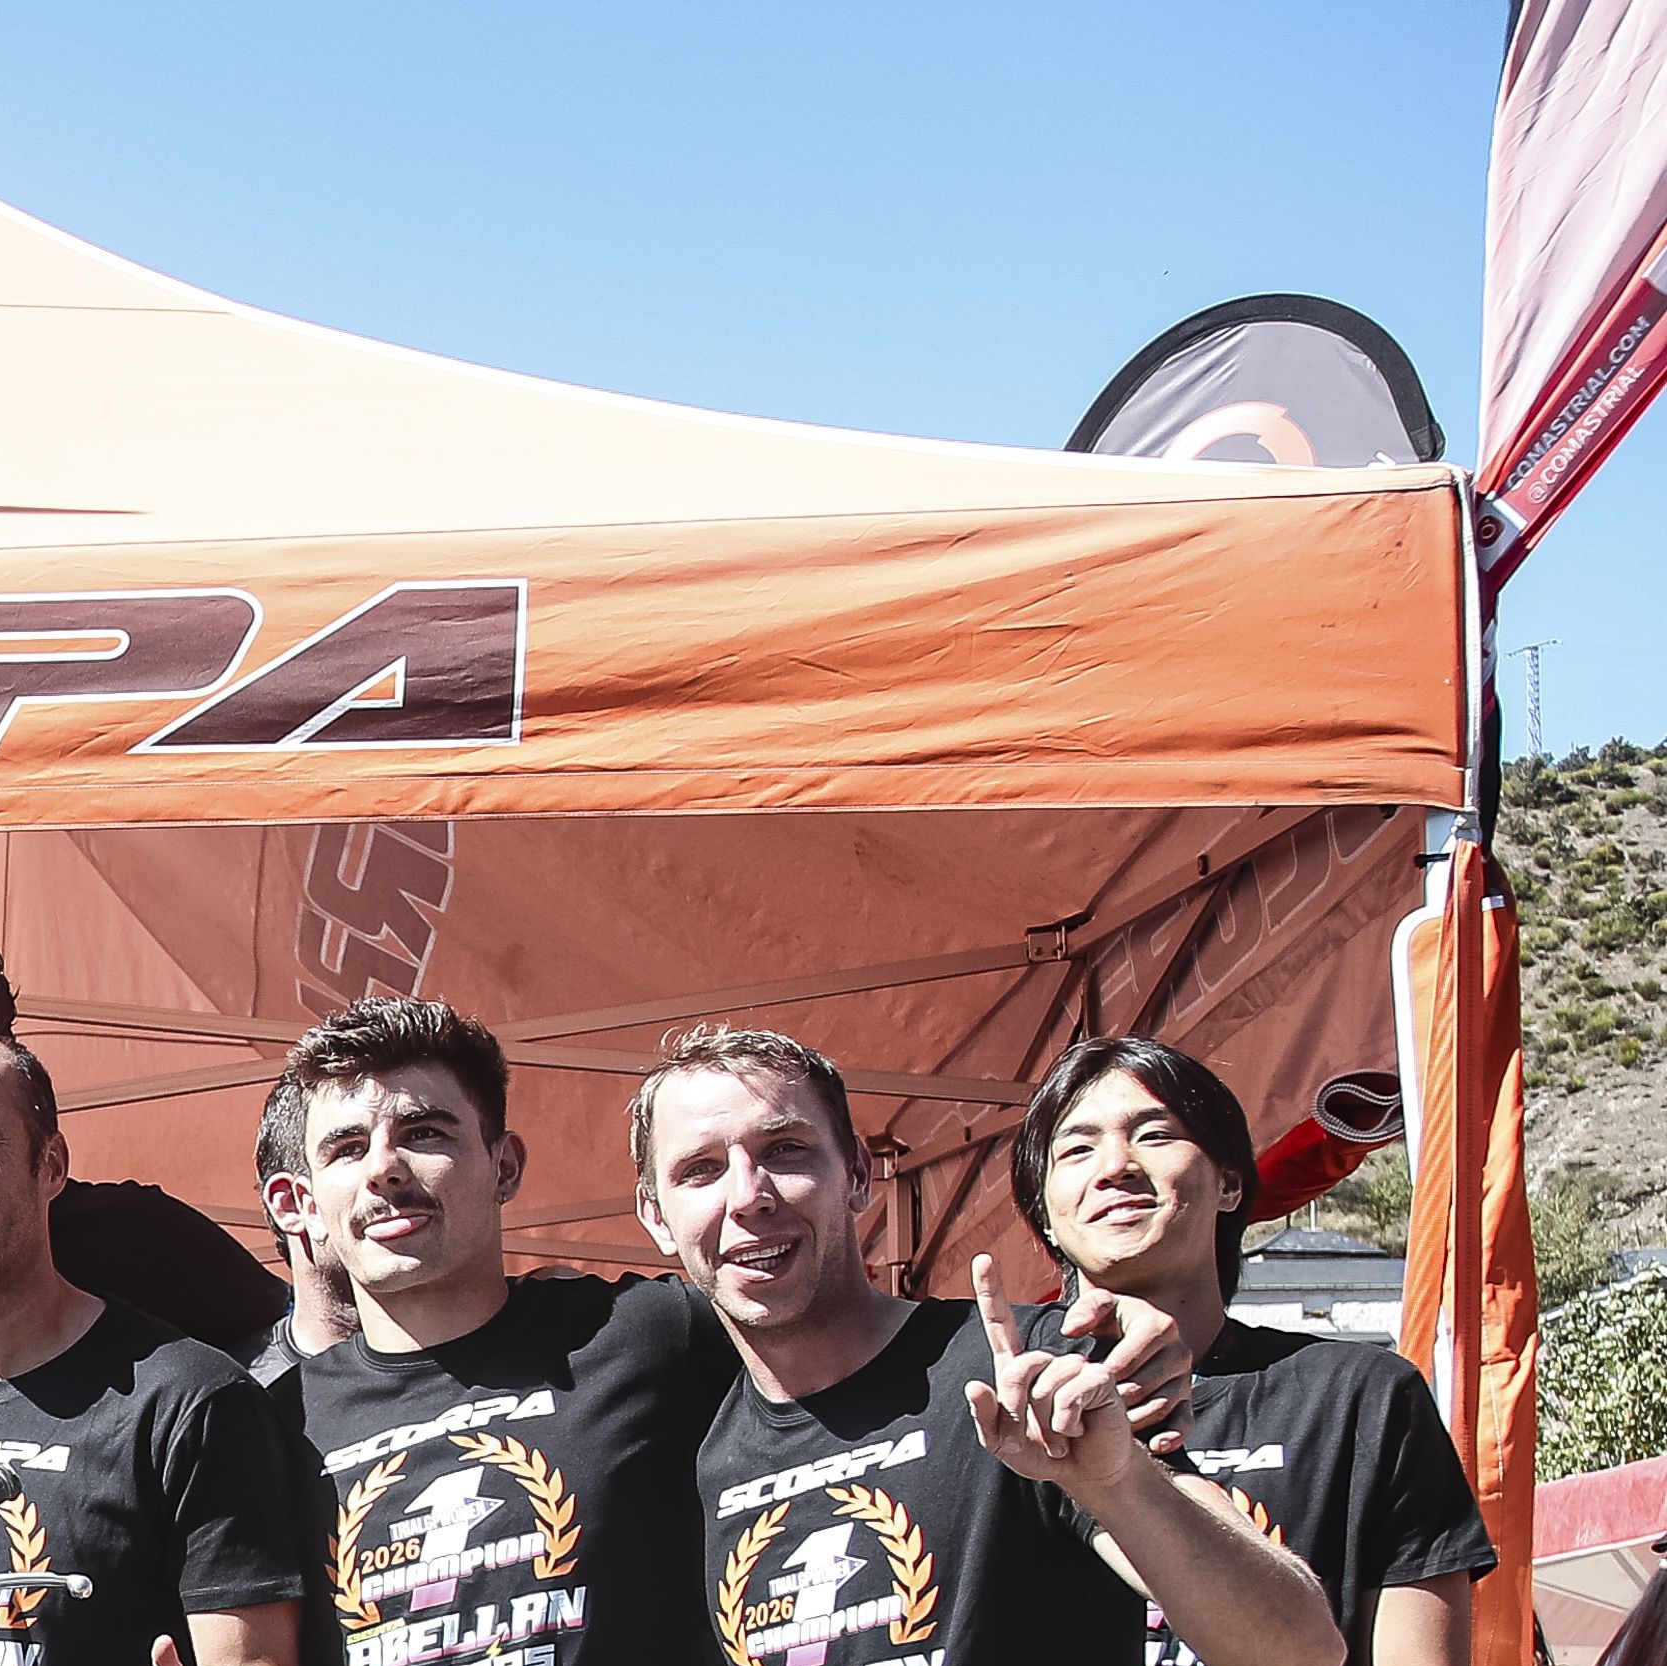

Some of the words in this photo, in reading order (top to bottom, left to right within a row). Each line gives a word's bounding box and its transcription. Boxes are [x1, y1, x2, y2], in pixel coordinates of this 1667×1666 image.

[1508, 315, 1651, 490] COMASTRIAL.COM
[1530, 362, 1646, 504] @COMASTRIAL
[320, 1390, 555, 1476] SCORPA
[716, 1430, 926, 1519] SCORPA
[360, 1538, 423, 1574] 2026
[360, 1532, 547, 1602] CHAMPION
[745, 1595, 794, 1629] 2026
[747, 1595, 903, 1658] CHAMPION
